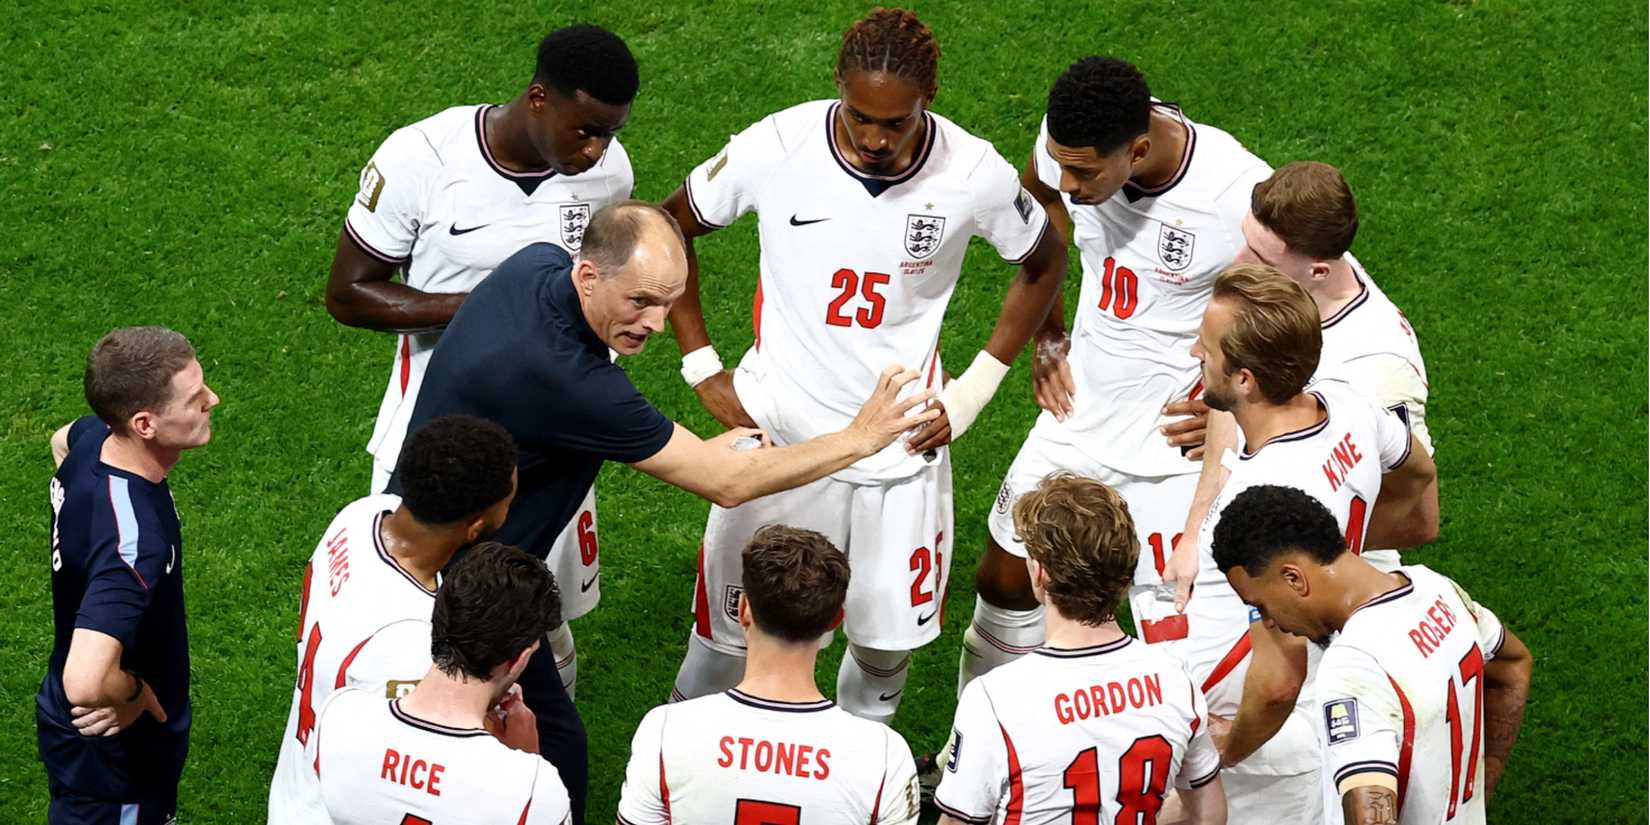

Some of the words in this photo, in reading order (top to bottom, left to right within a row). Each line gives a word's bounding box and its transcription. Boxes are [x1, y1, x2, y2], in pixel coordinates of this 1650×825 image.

[826, 268, 890, 330] 25
[1098, 256, 1138, 320] 10
[577, 510, 598, 567] 6
[1147, 532, 1185, 580] 1
[1408, 593, 1457, 659] ROER
[1055, 673, 1163, 725] GORDON
[717, 736, 831, 780] STONES
[1446, 641, 1485, 822] 17
[381, 748, 445, 796] RICE
[1063, 734, 1173, 825] 18
